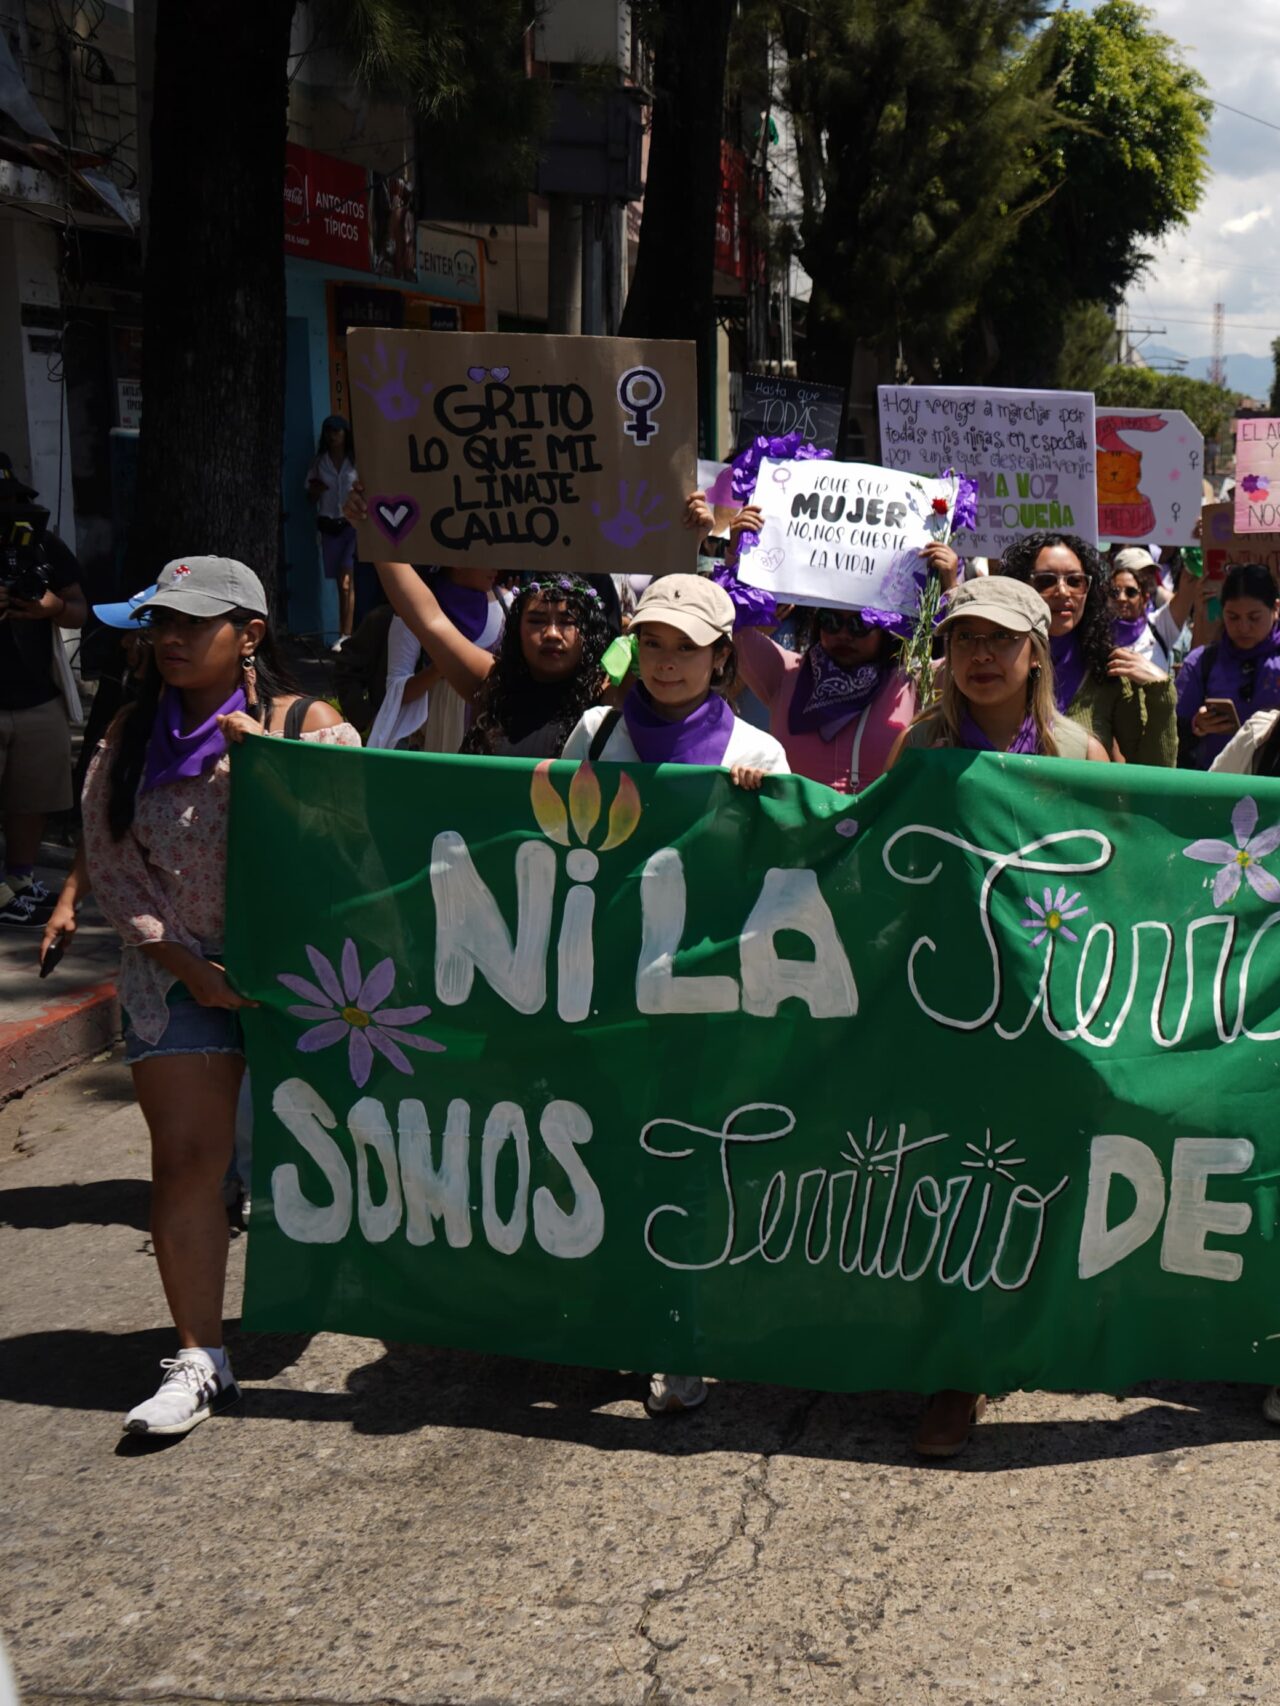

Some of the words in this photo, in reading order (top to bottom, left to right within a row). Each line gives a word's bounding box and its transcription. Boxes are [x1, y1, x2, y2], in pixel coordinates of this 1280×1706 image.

[315, 191, 364, 220] ANTOJITOS
[324, 216, 360, 241] TÍPICOS
[434, 383, 593, 436] GRITO
[755, 382, 786, 397] Hasta
[797, 389, 821, 408] que
[757, 399, 818, 440] TODAS
[883, 392, 919, 424] Hoy
[925, 399, 975, 427] vengo
[984, 400, 993, 417] a
[999, 401, 1052, 426] marchar
[1059, 407, 1085, 430] por
[886, 422, 926, 445] todas
[932, 426, 959, 452] mis
[1008, 431, 1030, 453] en
[1031, 429, 1087, 456] especial
[1243, 423, 1262, 441] EL
[409, 435, 448, 472] LO
[463, 435, 535, 475] QUE
[547, 435, 602, 472] MI
[886, 449, 911, 468] por
[957, 452, 983, 472] que
[1266, 442, 1279, 458] Y
[454, 473, 580, 511] LINAJE
[1016, 472, 1059, 499] VOZ
[791, 492, 907, 529] MUJER
[975, 501, 1075, 529] PEQUEÑA
[430, 506, 570, 550] CALLO.
[850, 529, 907, 551] CUESTE
[810, 549, 828, 568] LA
[835, 552, 875, 575] VIDA!
[636, 847, 859, 1019] LA
[271, 1076, 604, 1259] SOMOS
[640, 1102, 1069, 1291] Territorio
[1078, 1134, 1256, 1283] DE
